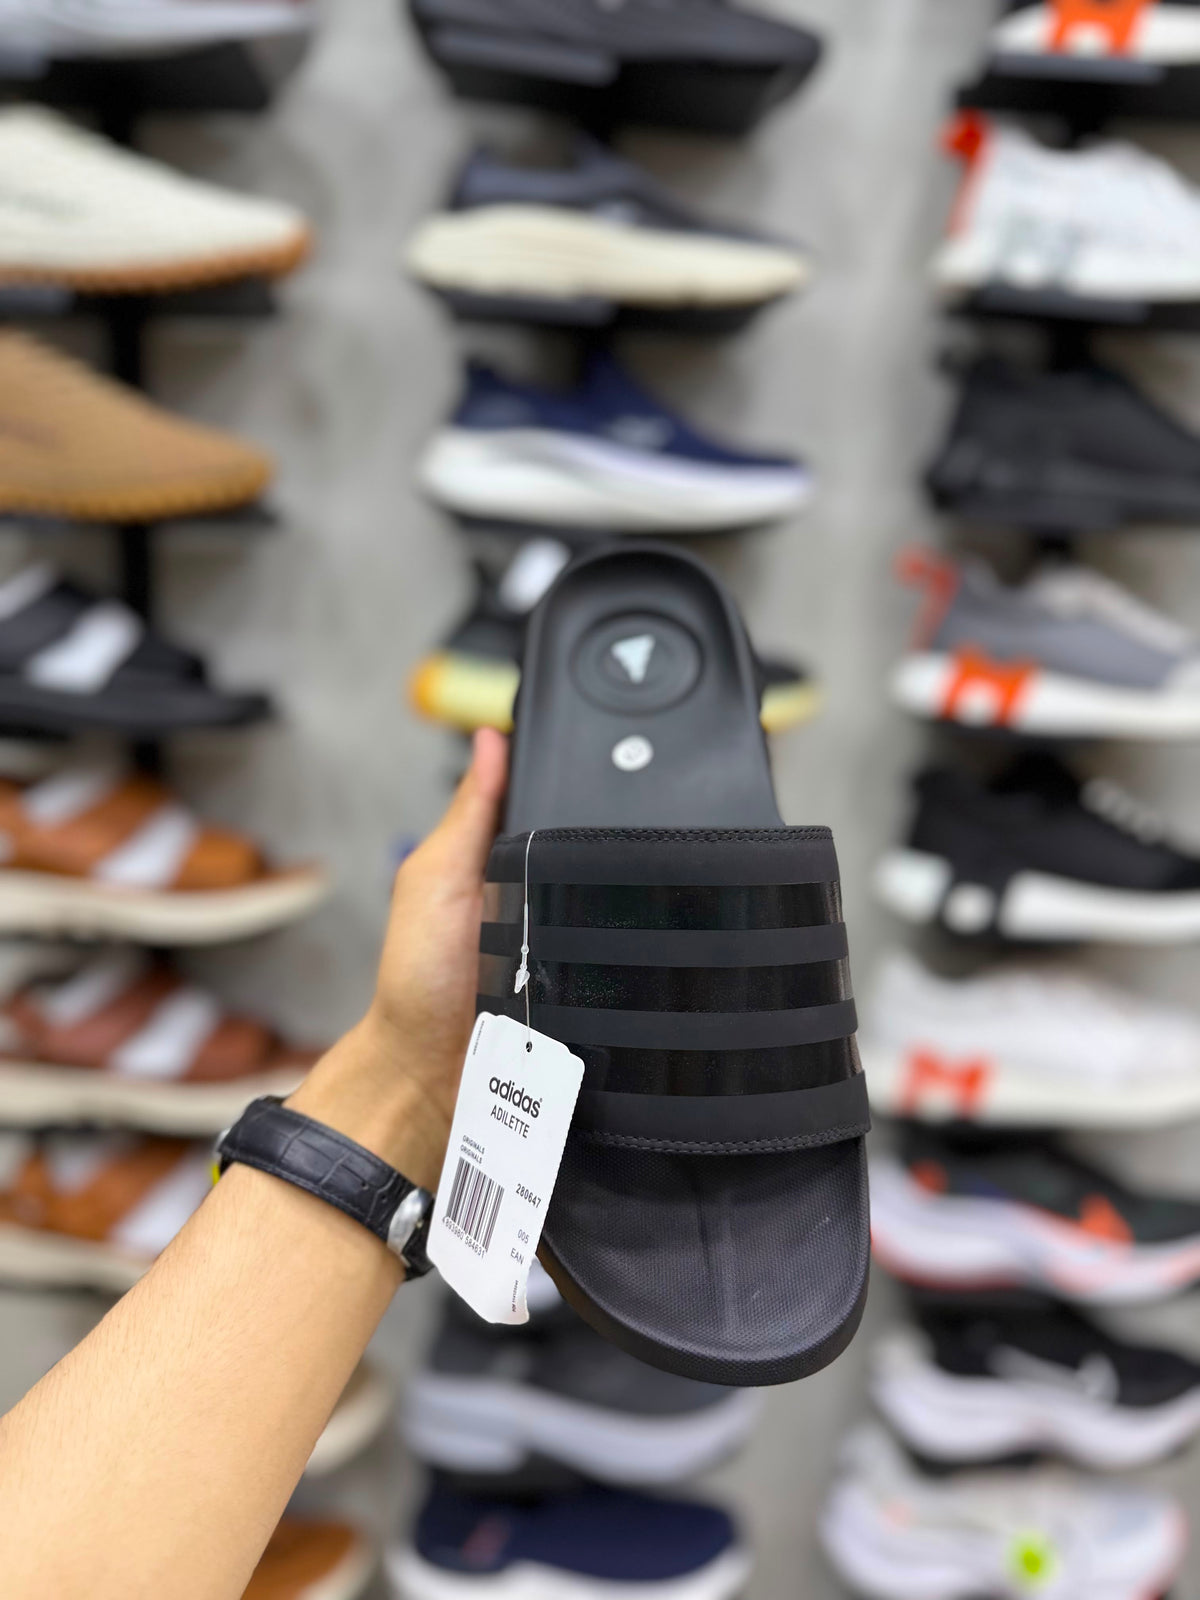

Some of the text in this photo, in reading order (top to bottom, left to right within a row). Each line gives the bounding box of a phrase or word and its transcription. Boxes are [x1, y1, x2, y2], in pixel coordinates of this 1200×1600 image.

[489, 1077, 541, 1118] adidas
[490, 1105, 530, 1138] ADILETTE
[516, 1183, 541, 1208] 280647
[510, 1248, 524, 1264] EAN
